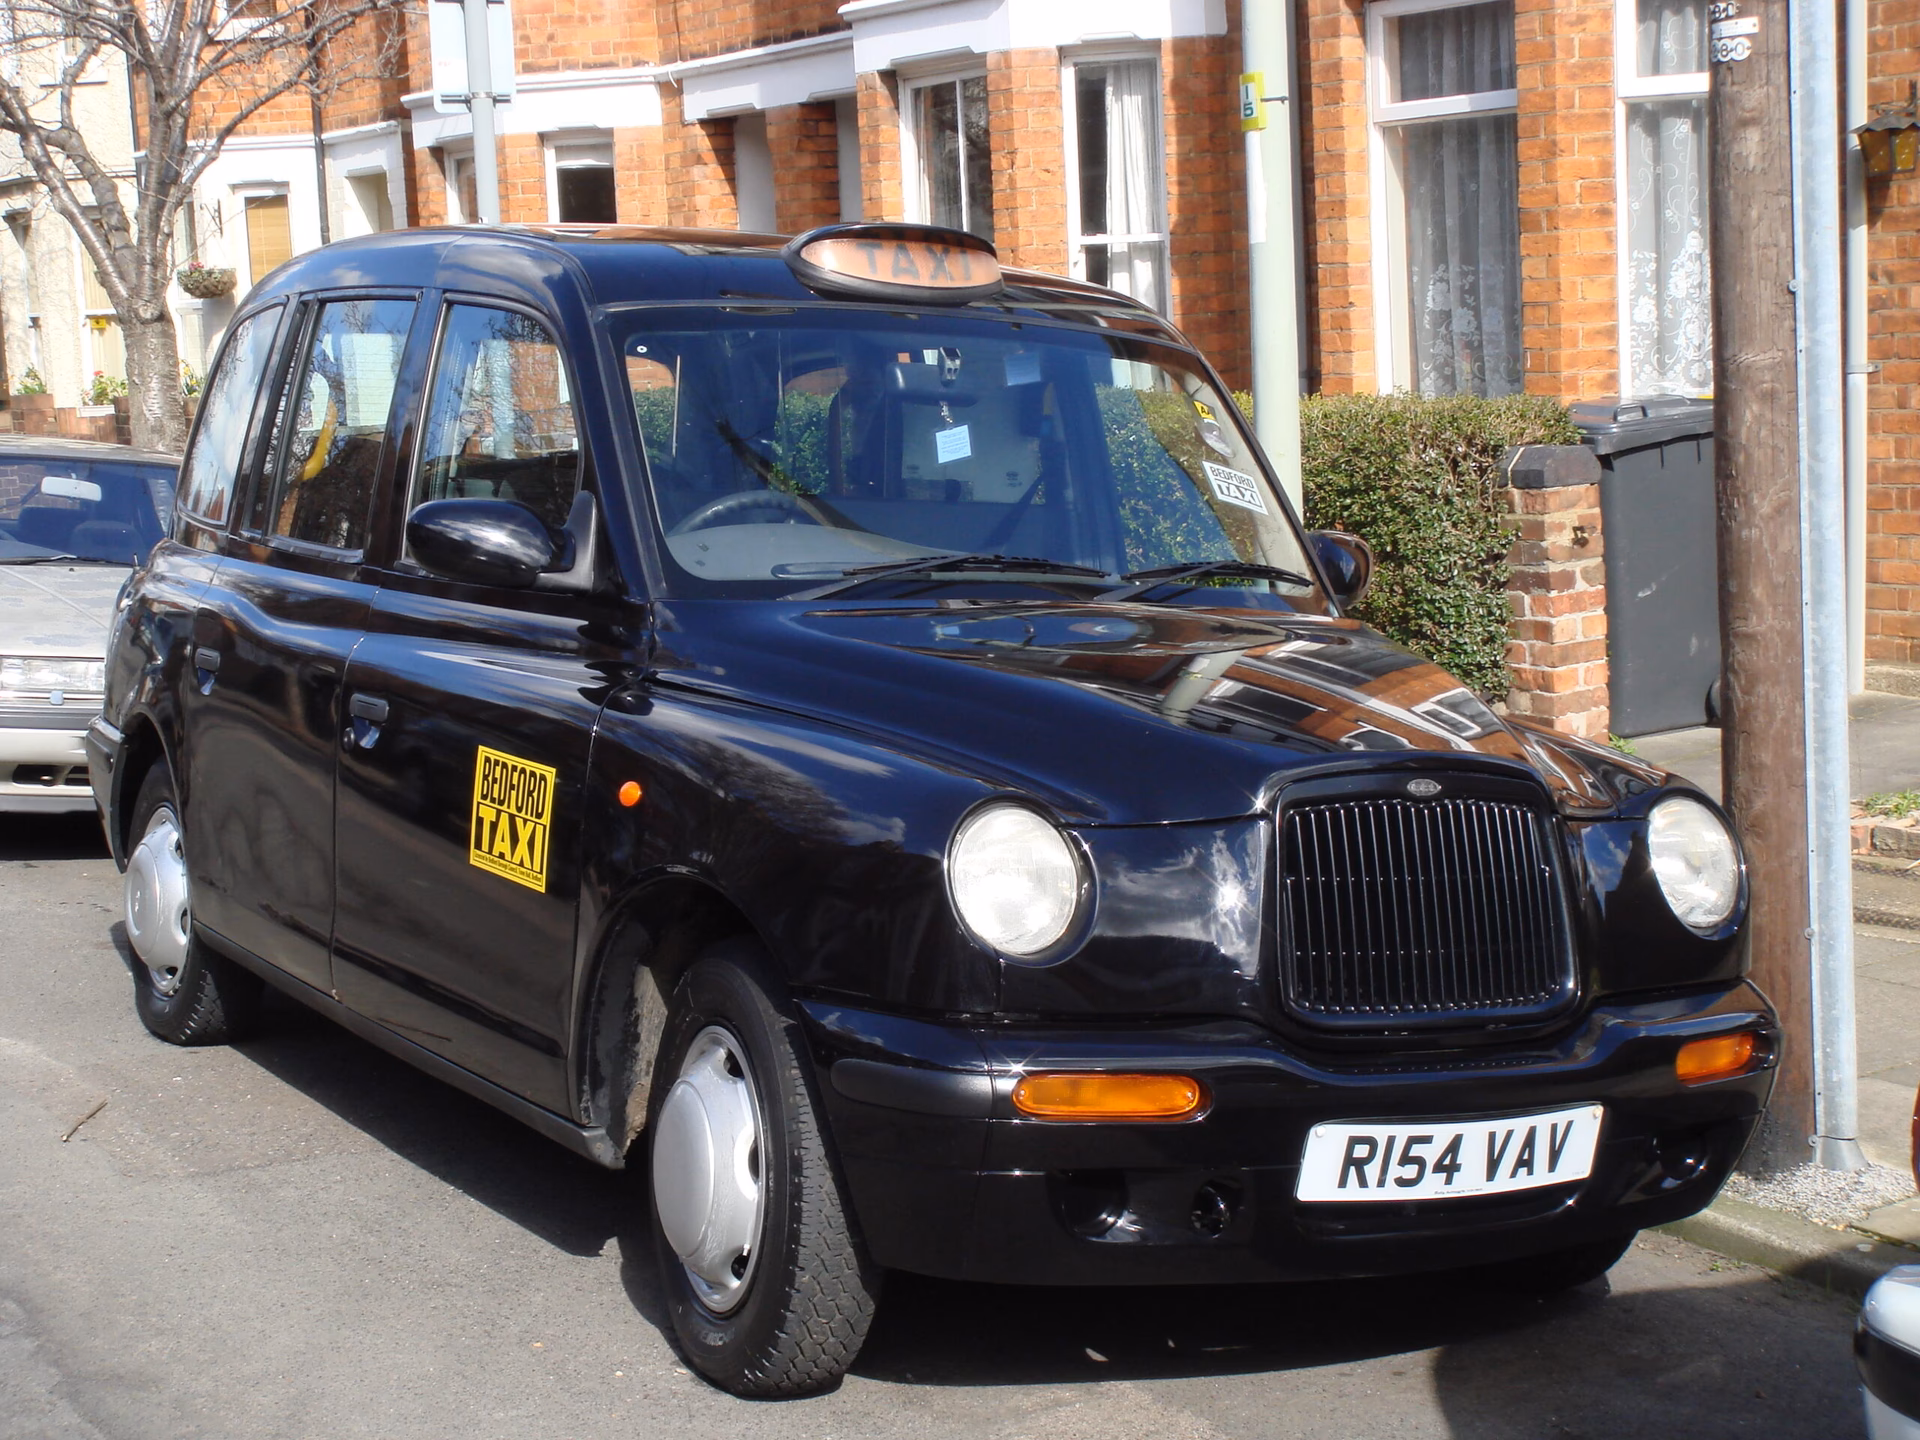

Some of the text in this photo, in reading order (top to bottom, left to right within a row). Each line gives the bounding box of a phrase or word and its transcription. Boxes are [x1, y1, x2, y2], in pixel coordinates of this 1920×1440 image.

[855, 242, 973, 281] TAXI
[1209, 466, 1255, 489] BEDFORD
[1216, 483, 1262, 507] TAXI
[480, 755, 548, 820] BEDFORD
[478, 803, 544, 873] TAXI
[1337, 1119, 1575, 1189] R154 VAV
